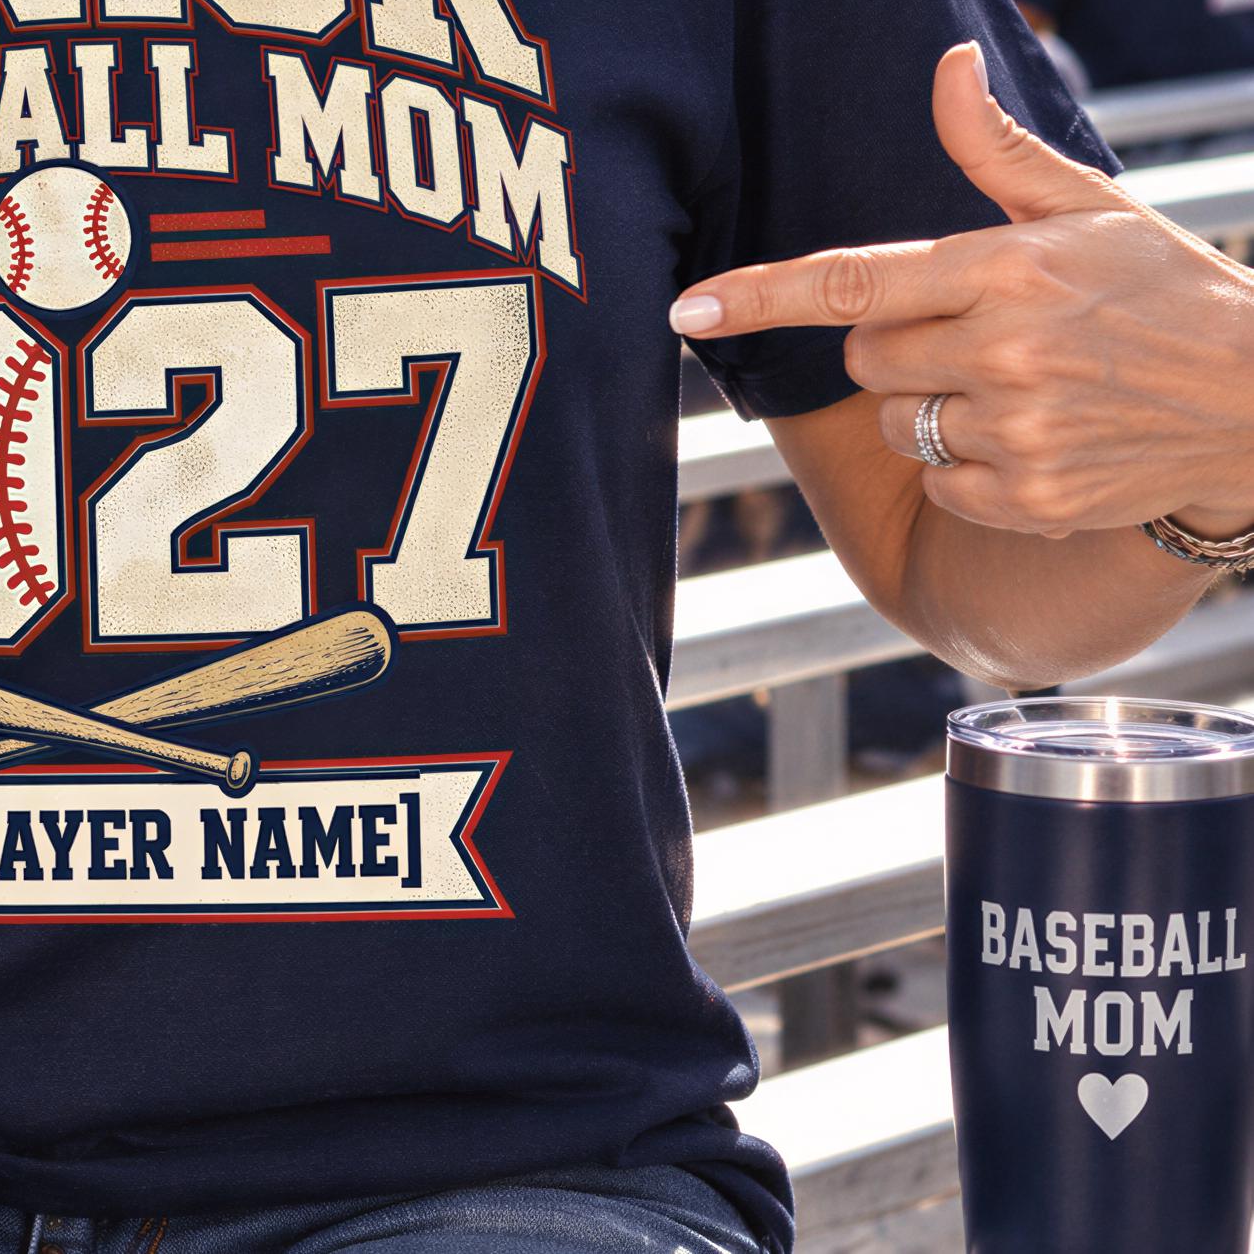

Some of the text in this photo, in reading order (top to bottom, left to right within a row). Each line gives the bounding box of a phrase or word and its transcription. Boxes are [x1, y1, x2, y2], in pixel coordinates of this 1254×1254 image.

[263, 48, 585, 298] MOM
[201, 793, 422, 888] NAME]
[981, 900, 1246, 978] BASEBALL
[1033, 986, 1194, 1056] MOM
